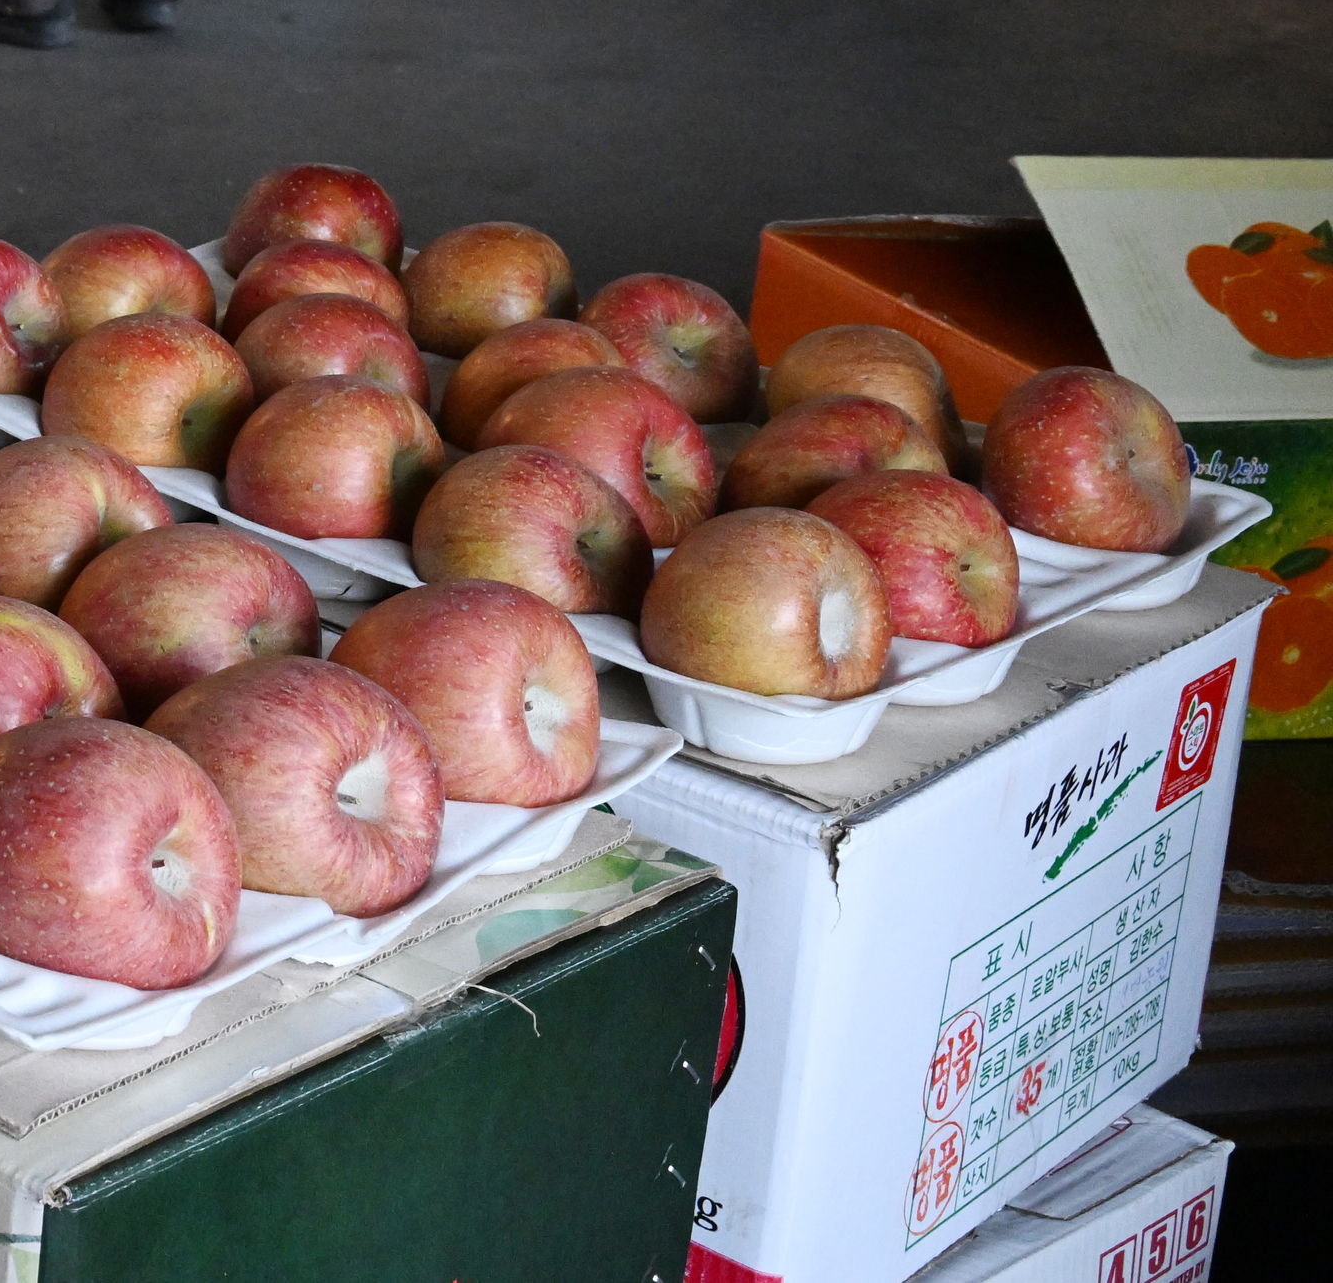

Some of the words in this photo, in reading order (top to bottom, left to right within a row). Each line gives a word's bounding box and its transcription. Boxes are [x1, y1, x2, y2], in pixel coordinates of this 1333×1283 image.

[1229, 456, 1269, 478] Jeju
[1024, 731, 1128, 850] 명품사과
[1116, 883, 1161, 936] 생산자
[1087, 956, 1112, 994] 성명
[1130, 920, 1163, 964] 김한수
[988, 992, 1016, 1034] 품종
[1029, 946, 1084, 1003] 로얄부사
[1079, 1000, 1103, 1034] 주소
[930, 1019, 978, 1111] 명품
[1076, 1035, 1098, 1060] 전화
[979, 1048, 1007, 1088] 등급
[1072, 1054, 1095, 1083] 번호
[1065, 1082, 1091, 1119] 무게
[971, 1106, 998, 1145] 갯수
[912, 1130, 959, 1223] 명품
[962, 1162, 990, 1198] 산지
[1148, 1223, 1167, 1275] 5
[1186, 1200, 1206, 1250] 6
